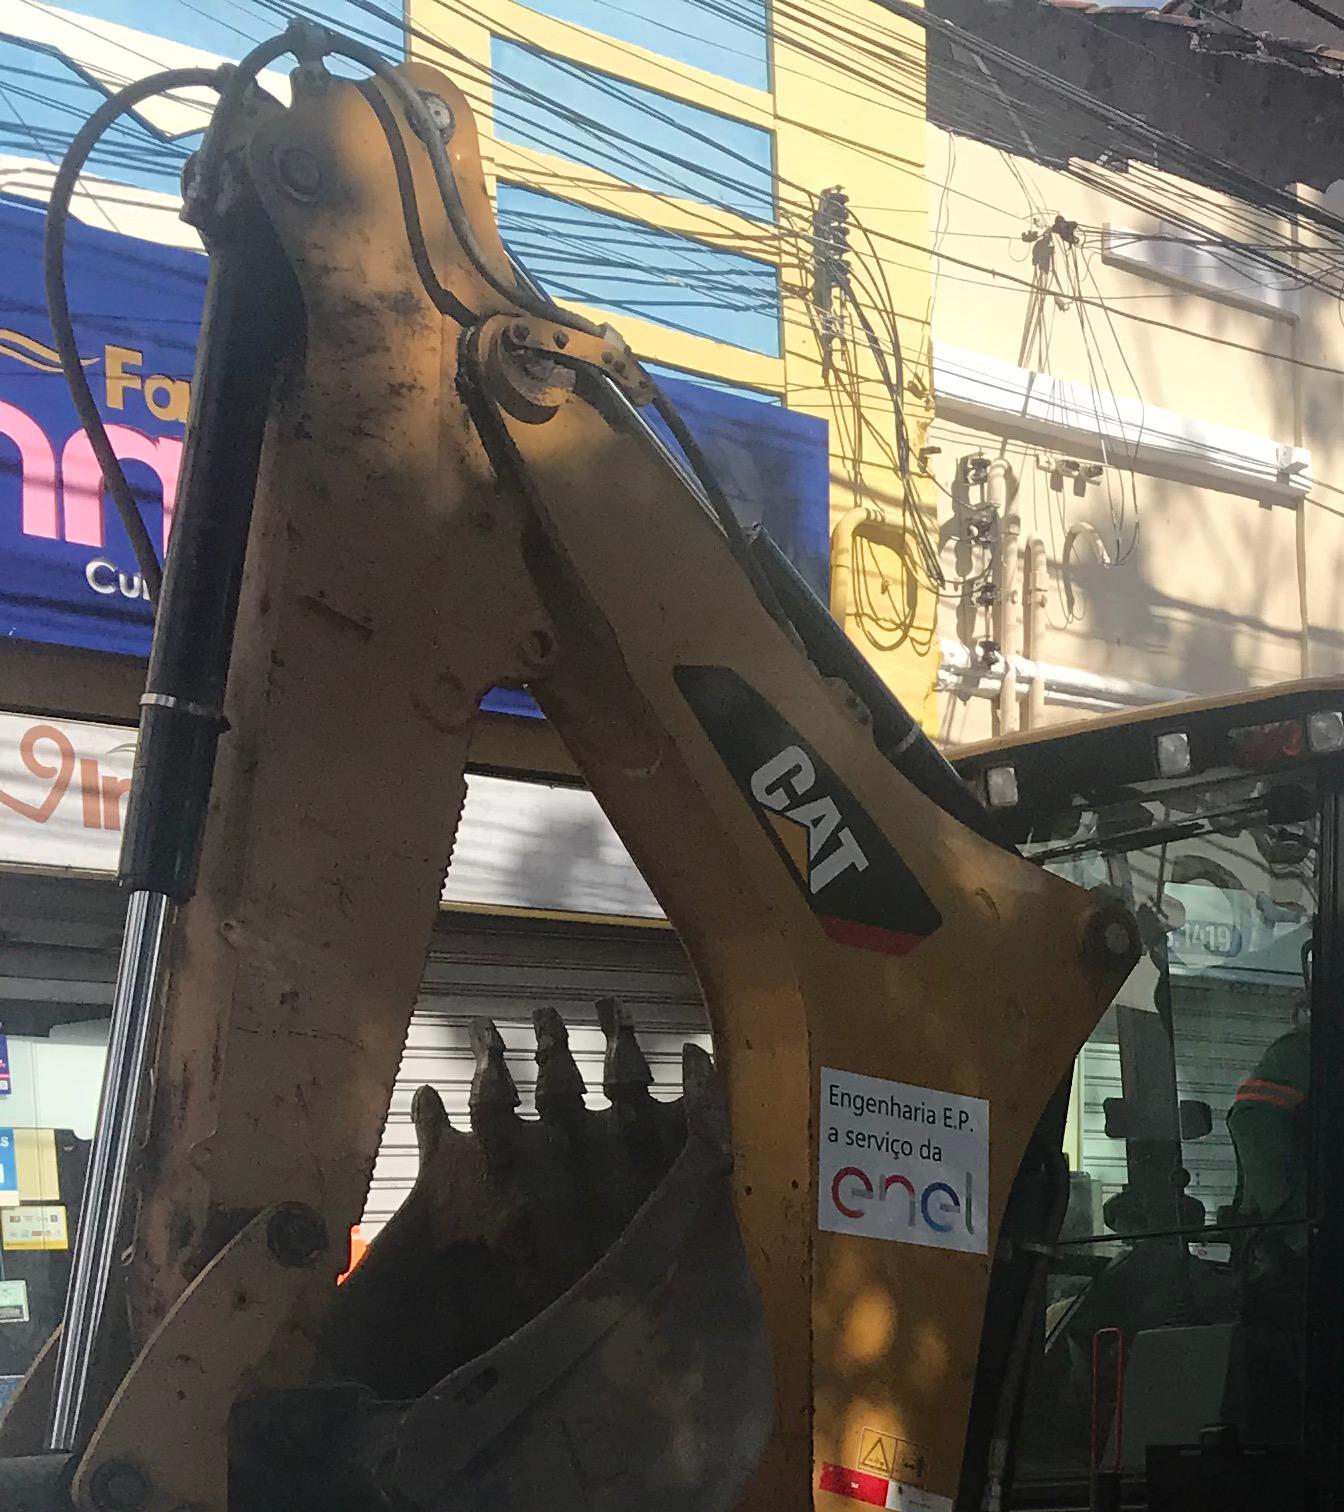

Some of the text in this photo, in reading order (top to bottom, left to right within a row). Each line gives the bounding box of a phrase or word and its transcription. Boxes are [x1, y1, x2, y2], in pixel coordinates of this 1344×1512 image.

[750, 745, 870, 894] CAT
[829, 1085, 974, 1133] Engenharia E.P.
[828, 1126, 942, 1162] a serviço da
[831, 1166, 975, 1235] enel
